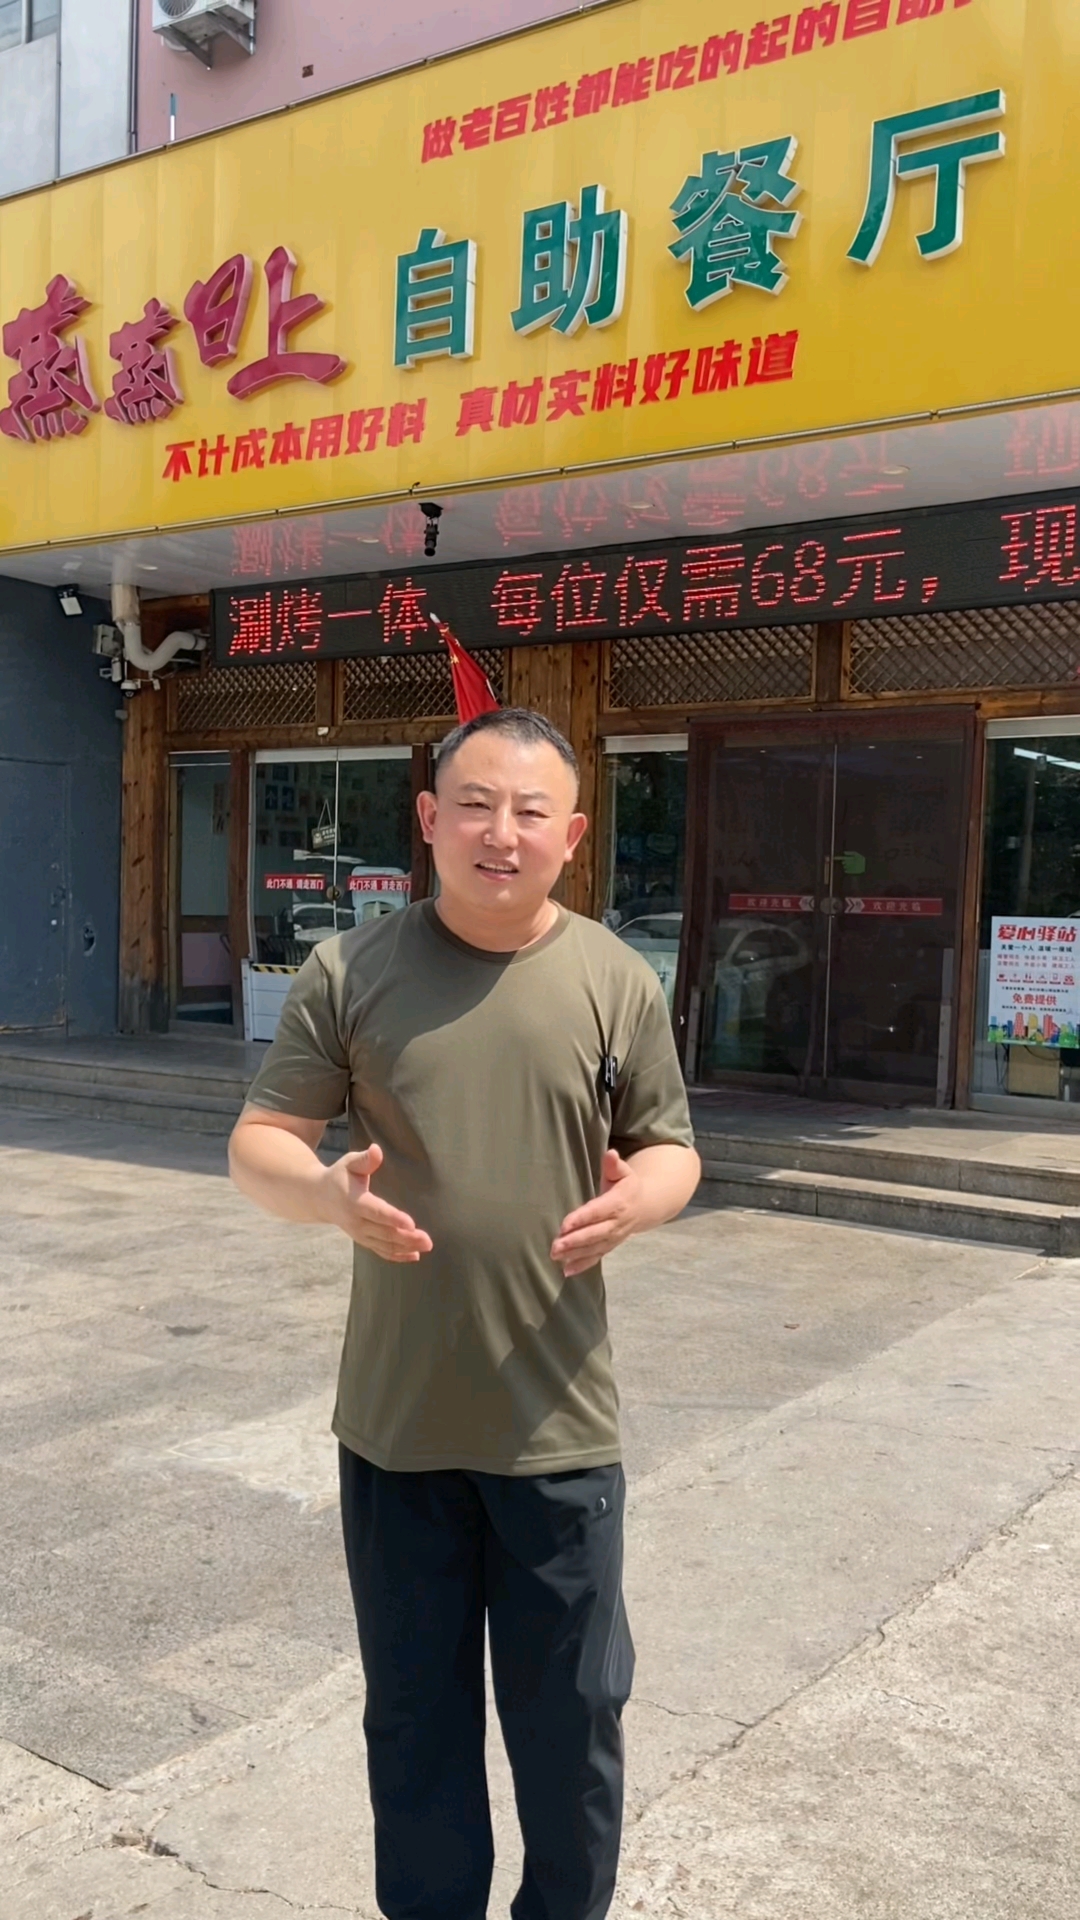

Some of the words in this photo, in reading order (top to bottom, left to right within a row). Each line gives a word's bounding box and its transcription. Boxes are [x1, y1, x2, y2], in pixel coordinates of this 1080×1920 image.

[421, 0, 973, 163] 做老百姓都能吃的起的自助
[0, 244, 350, 444] 蒸蒸日上
[393, 87, 1006, 370] 自助餐厅
[162, 397, 427, 482] 不计成本用好料
[455, 329, 800, 437] 真材实料好味道
[266, 878, 293, 889] 此门不通
[296, 879, 324, 890] 请走西门
[349, 880, 377, 891] 此门不通
[997, 924, 1077, 942] 爱心驿站
[1012, 992, 1057, 1006] 免费提供
